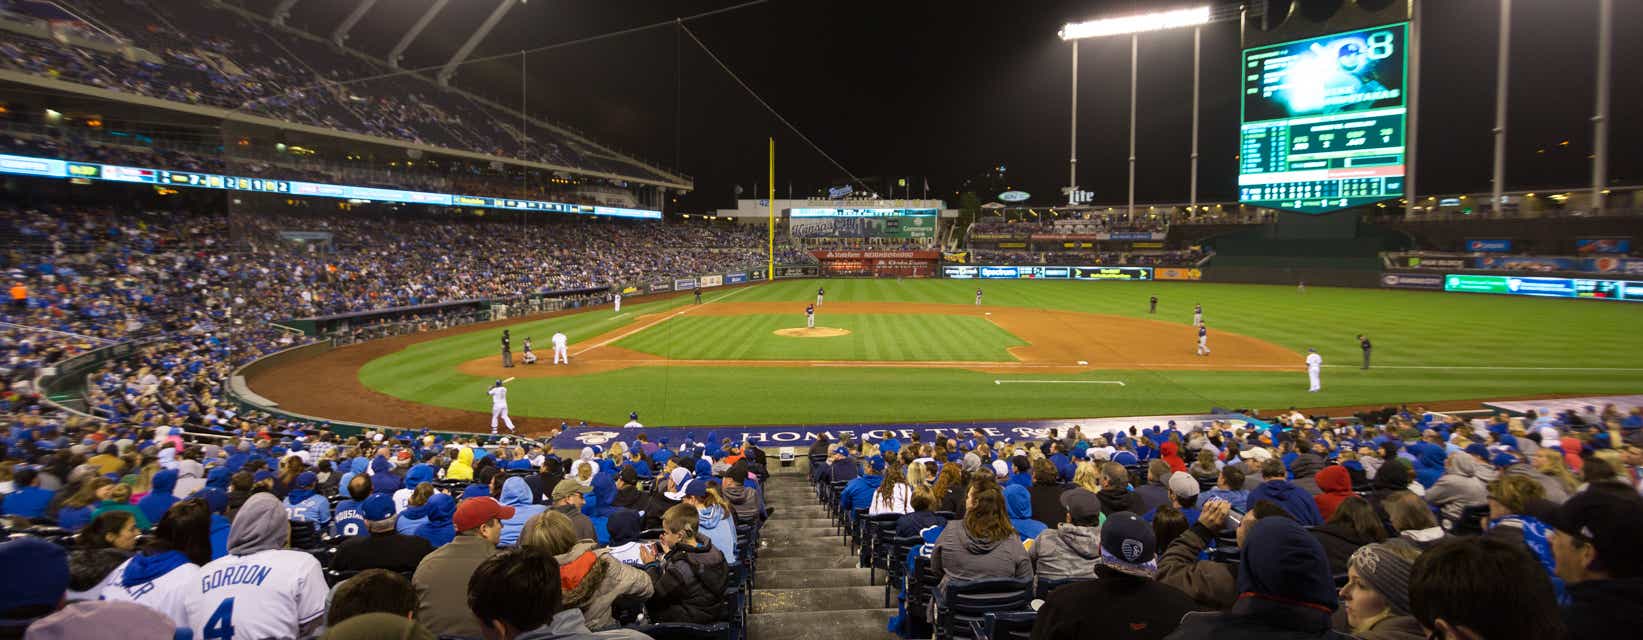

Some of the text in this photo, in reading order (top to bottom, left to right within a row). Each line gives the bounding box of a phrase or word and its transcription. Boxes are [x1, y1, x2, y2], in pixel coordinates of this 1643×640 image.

[1366, 31, 1395, 60] 8
[279, 182, 288, 192] 2
[1068, 190, 1094, 205] Lite
[1294, 200, 1302, 209] 2
[982, 268, 1017, 276] Spectrum
[741, 431, 859, 442] HOME
[868, 429, 914, 439] OF
[925, 427, 1004, 438] THE
[202, 564, 272, 594] GORDON
[203, 596, 235, 640] 4
